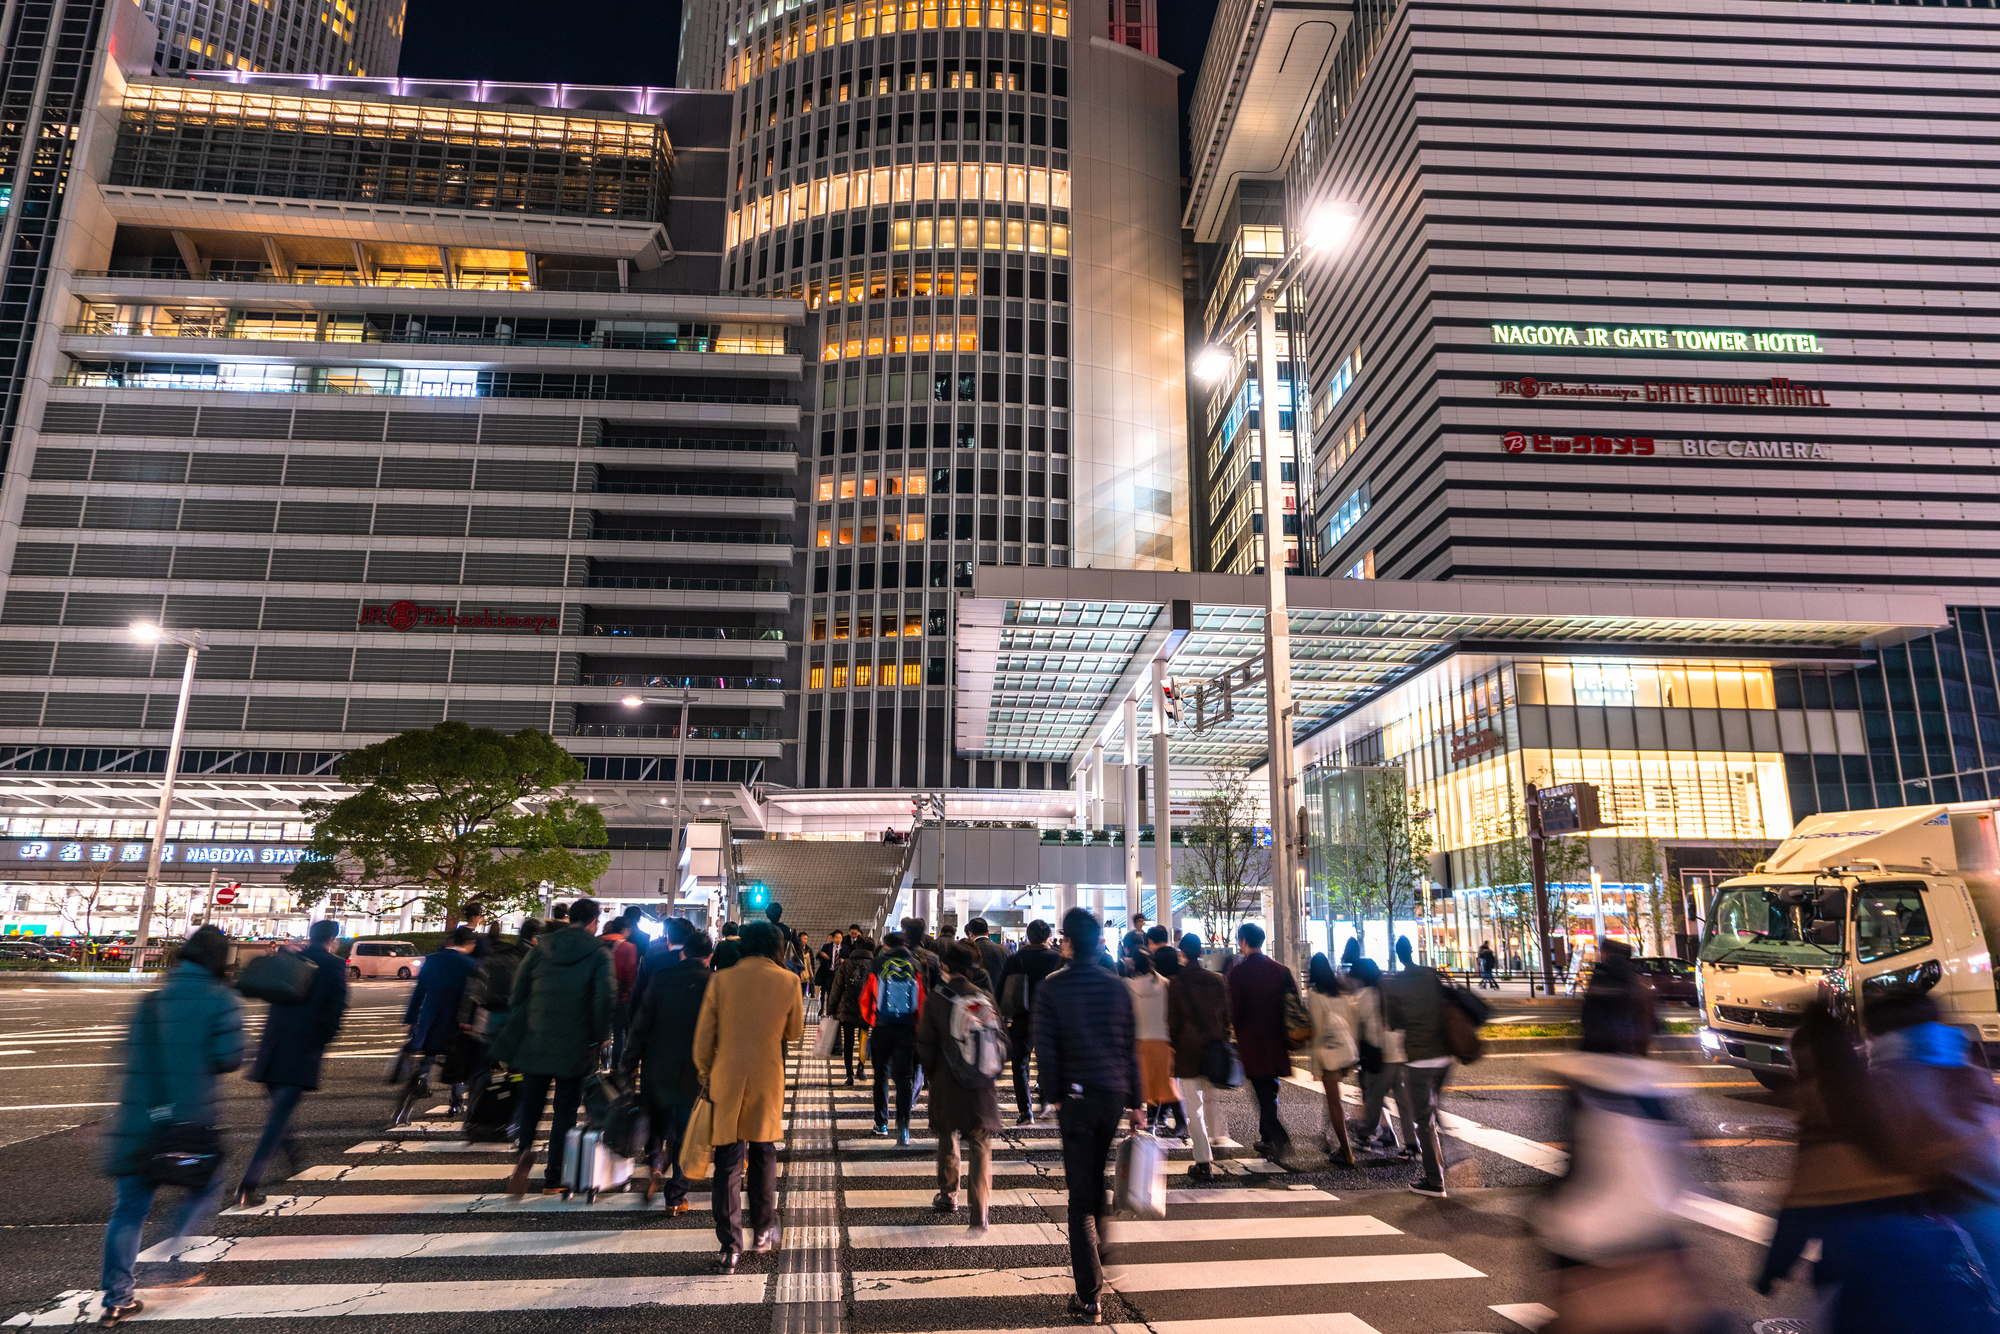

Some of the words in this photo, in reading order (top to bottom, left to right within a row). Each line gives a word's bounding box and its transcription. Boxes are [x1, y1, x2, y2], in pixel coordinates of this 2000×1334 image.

[1492, 325, 1579, 345] NAGOYA
[1584, 328, 1609, 346] JR
[1613, 329, 1668, 349] GATE
[1672, 330, 1749, 351] TOWER
[1752, 333, 1824, 353] HOTEL
[1499, 381, 1518, 394] JR
[1541, 382, 1639, 401] Takashimaya
[1532, 434, 1655, 455] ビックカメラ
[1682, 439, 1722, 456] BIC
[1727, 440, 1826, 459] CAMERA
[358, 606, 383, 625] JR
[420, 607, 559, 633] Takashimaya
[21, 842, 47, 857] JR
[186, 847, 254, 862] NAGOYA
